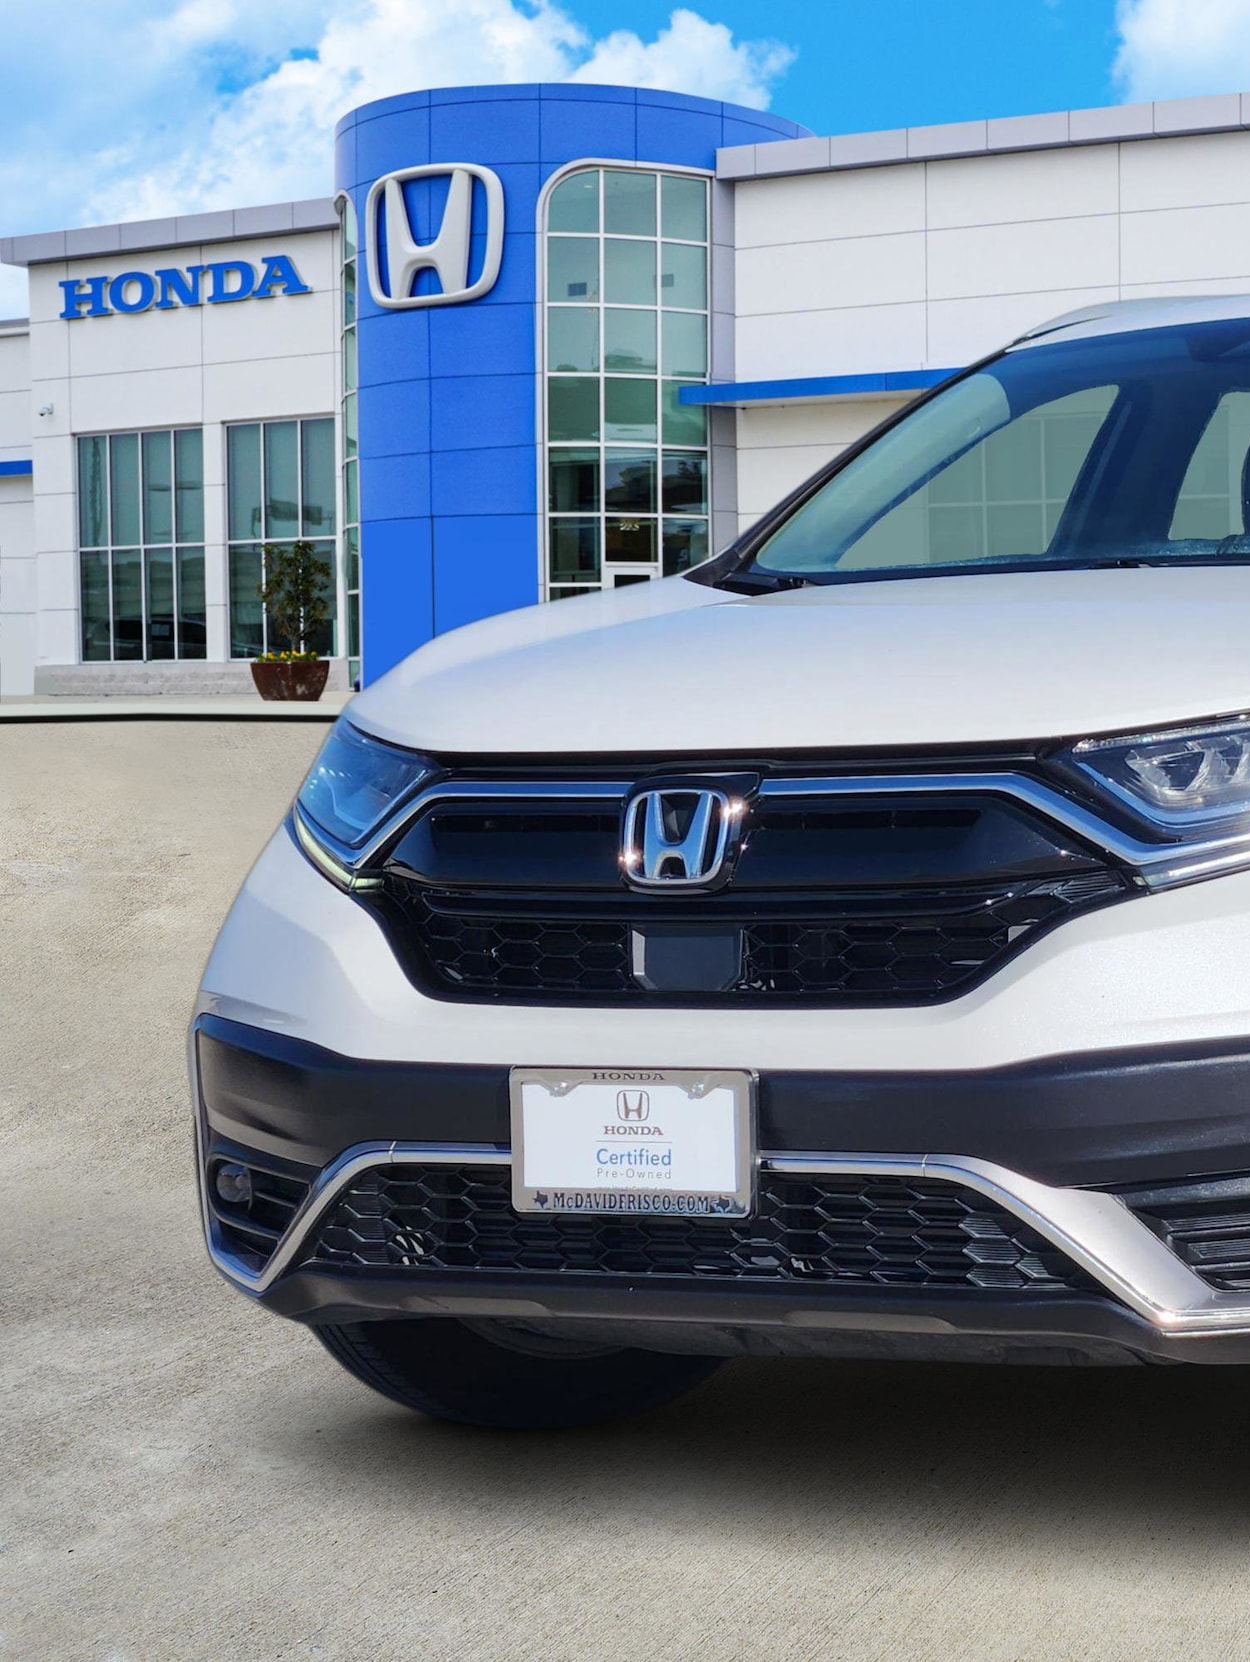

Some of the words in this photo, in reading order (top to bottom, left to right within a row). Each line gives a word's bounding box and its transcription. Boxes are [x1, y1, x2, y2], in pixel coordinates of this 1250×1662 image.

[59, 254, 311, 320] HONDA
[593, 1072, 666, 1080] HONDA
[604, 1126, 664, 1135] HONDA
[596, 1148, 672, 1166] Certified
[596, 1168, 672, 1179] Pre-Owned
